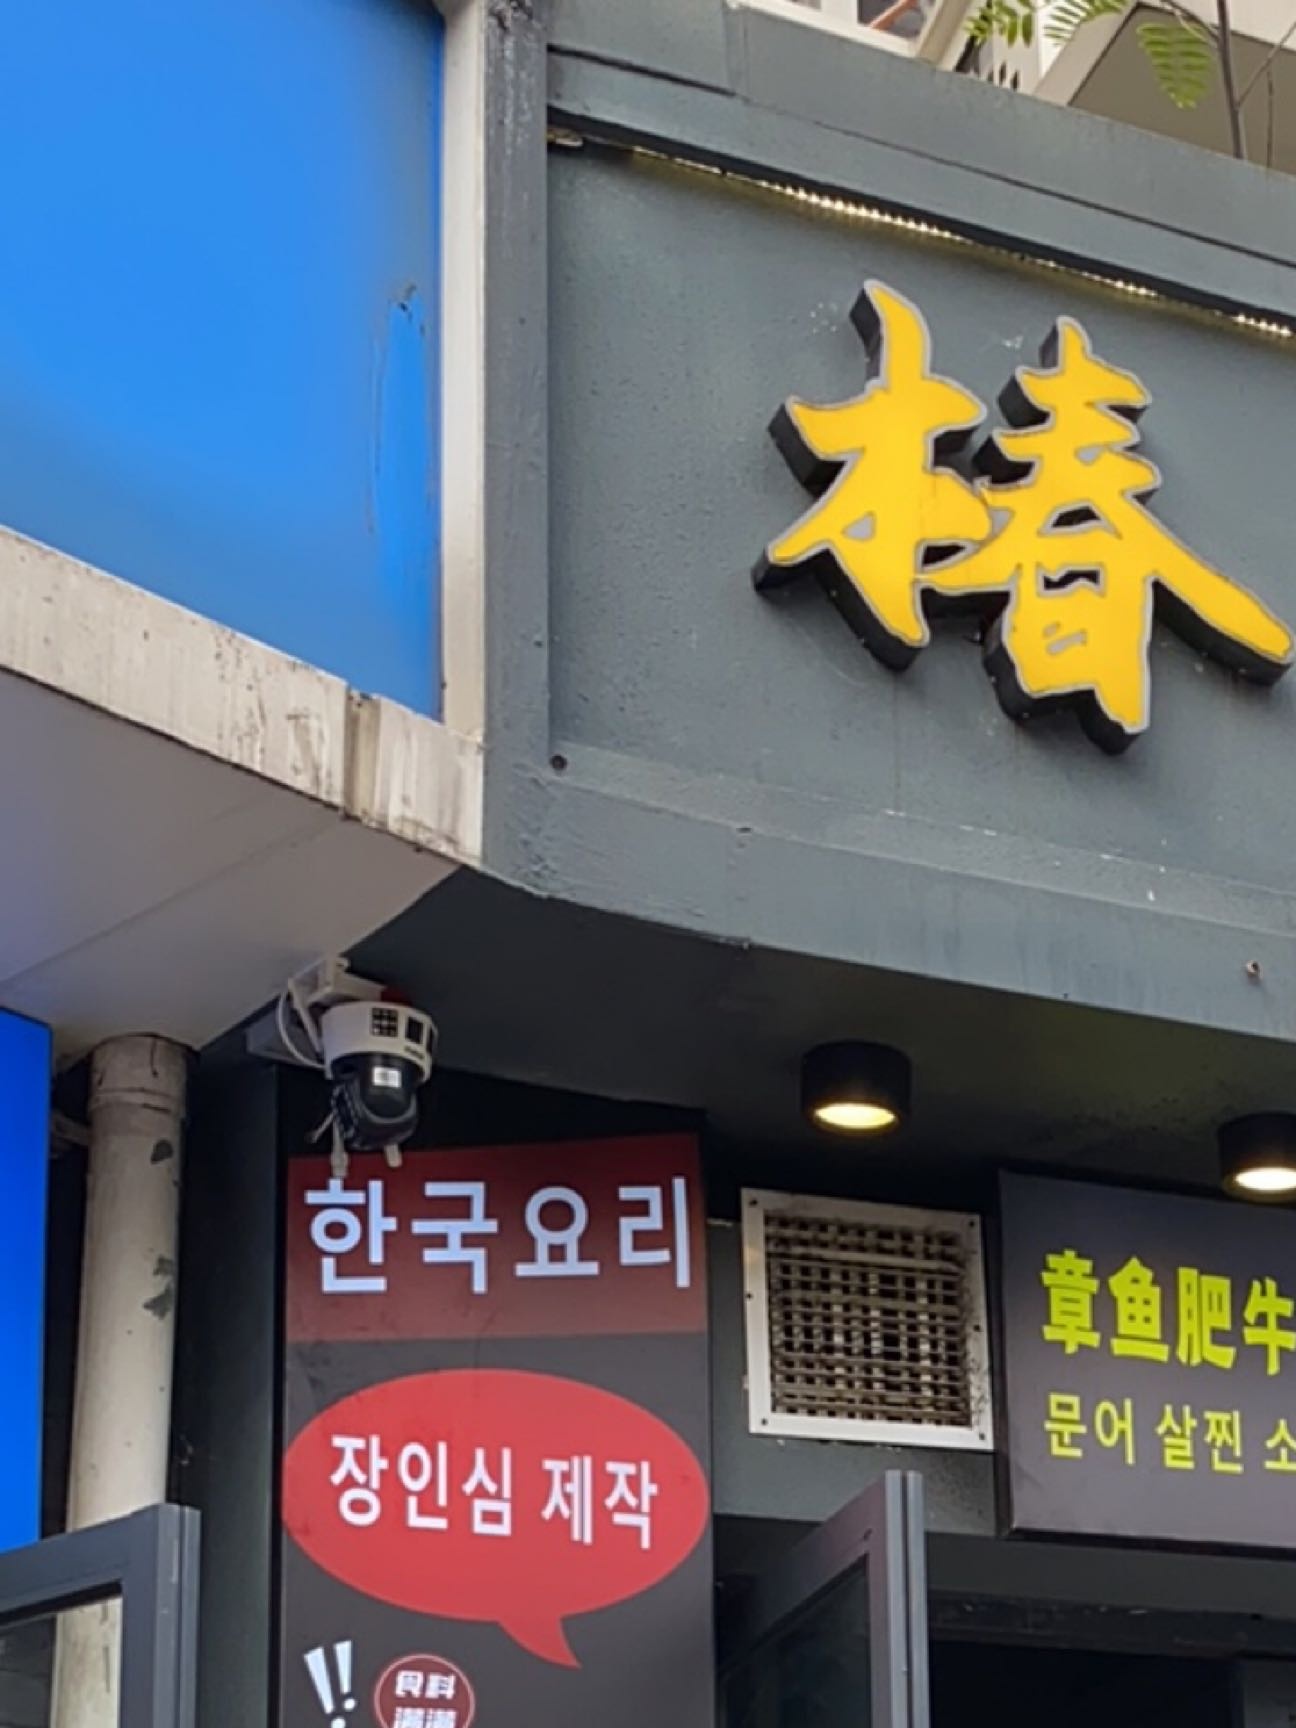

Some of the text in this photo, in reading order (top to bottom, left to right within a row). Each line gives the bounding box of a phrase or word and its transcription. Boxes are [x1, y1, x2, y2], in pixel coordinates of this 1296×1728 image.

[304, 1176, 691, 1294] 한국요리
[1044, 1393, 1135, 1465] 문어
[1155, 1402, 1245, 1474] 살찐
[330, 1434, 659, 1550] 장인심 제작
